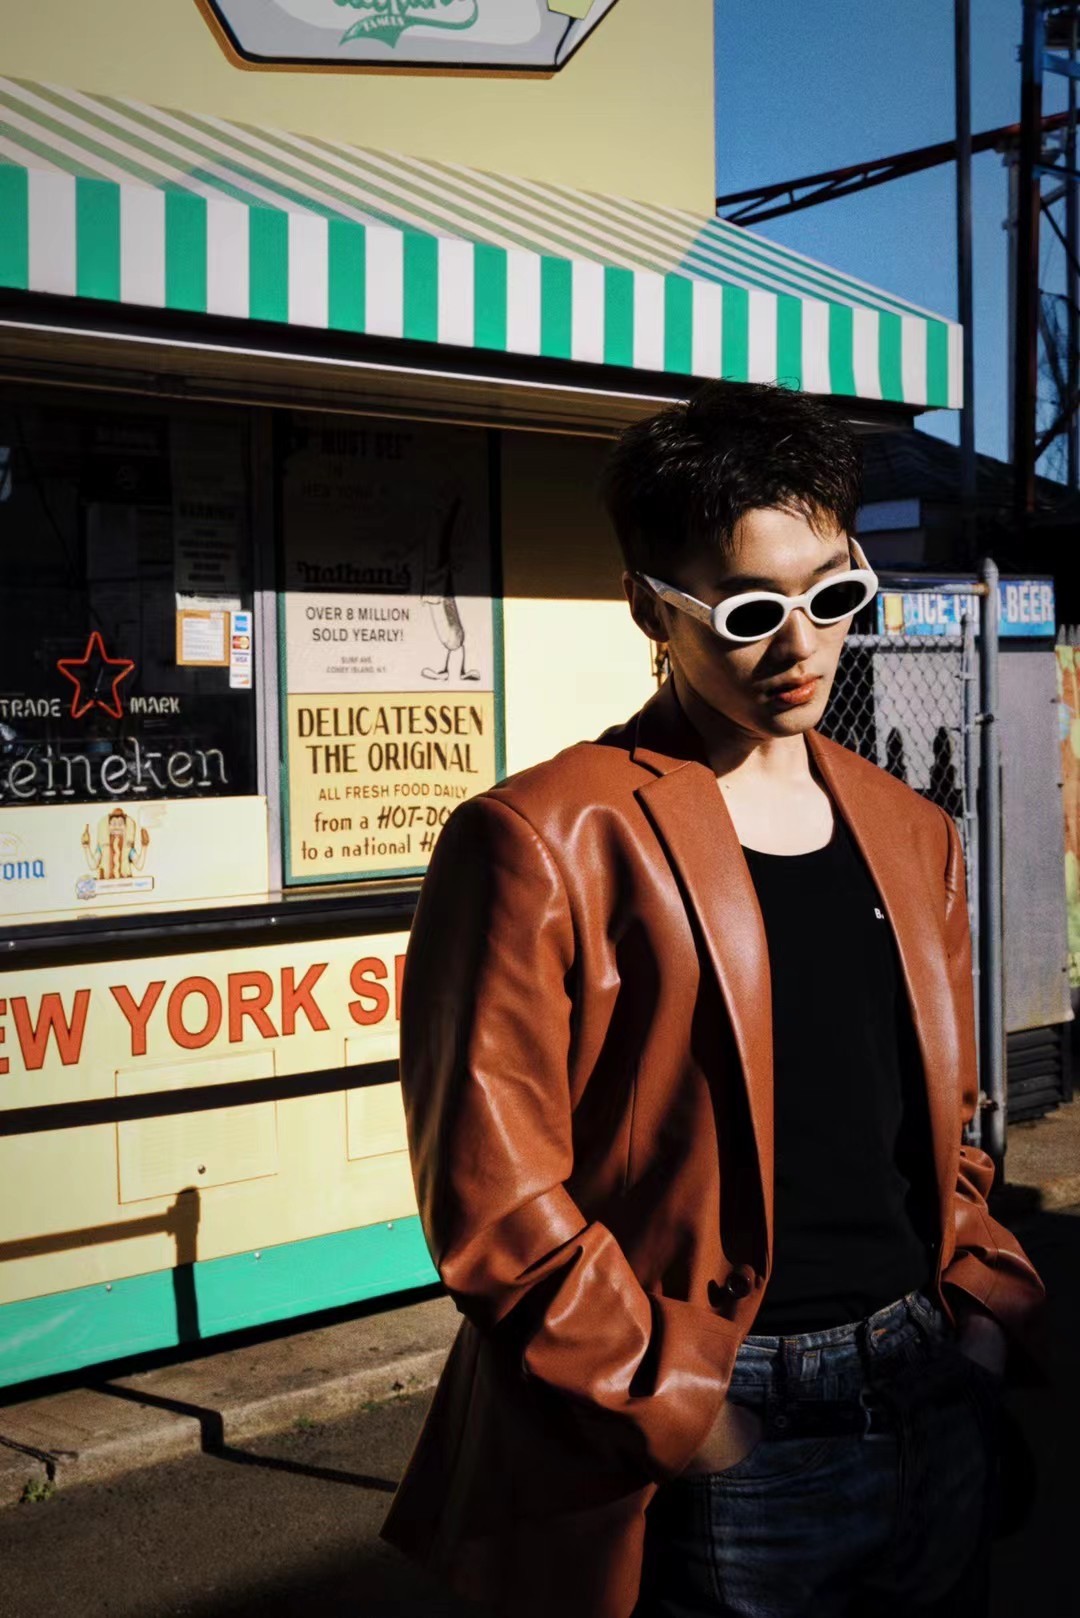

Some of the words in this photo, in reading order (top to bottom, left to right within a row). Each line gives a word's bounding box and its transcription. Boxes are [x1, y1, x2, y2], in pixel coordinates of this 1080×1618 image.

[305, 606, 342, 620] OVER
[346, 607, 354, 620] 8
[358, 608, 409, 621] MILLION
[1006, 585, 1053, 622] BEER
[312, 627, 348, 641] SOLD
[353, 629, 404, 642] YEARLY!
[0, 698, 62, 718] TRADE
[130, 696, 181, 714] MARK
[297, 705, 483, 737] DELICATESSEN
[0, 736, 228, 798] eineken
[305, 743, 358, 774] THE
[368, 741, 478, 773] ORIGINAL
[319, 787, 341, 801] ALL
[345, 785, 390, 799] FRESH
[394, 783, 430, 797] FOOD
[434, 784, 468, 799] DAILY
[314, 812, 352, 832] from
[360, 816, 369, 830] a
[301, 841, 318, 860] to
[324, 846, 334, 858] a
[342, 834, 411, 857] national
[109, 963, 331, 1056] YORK
